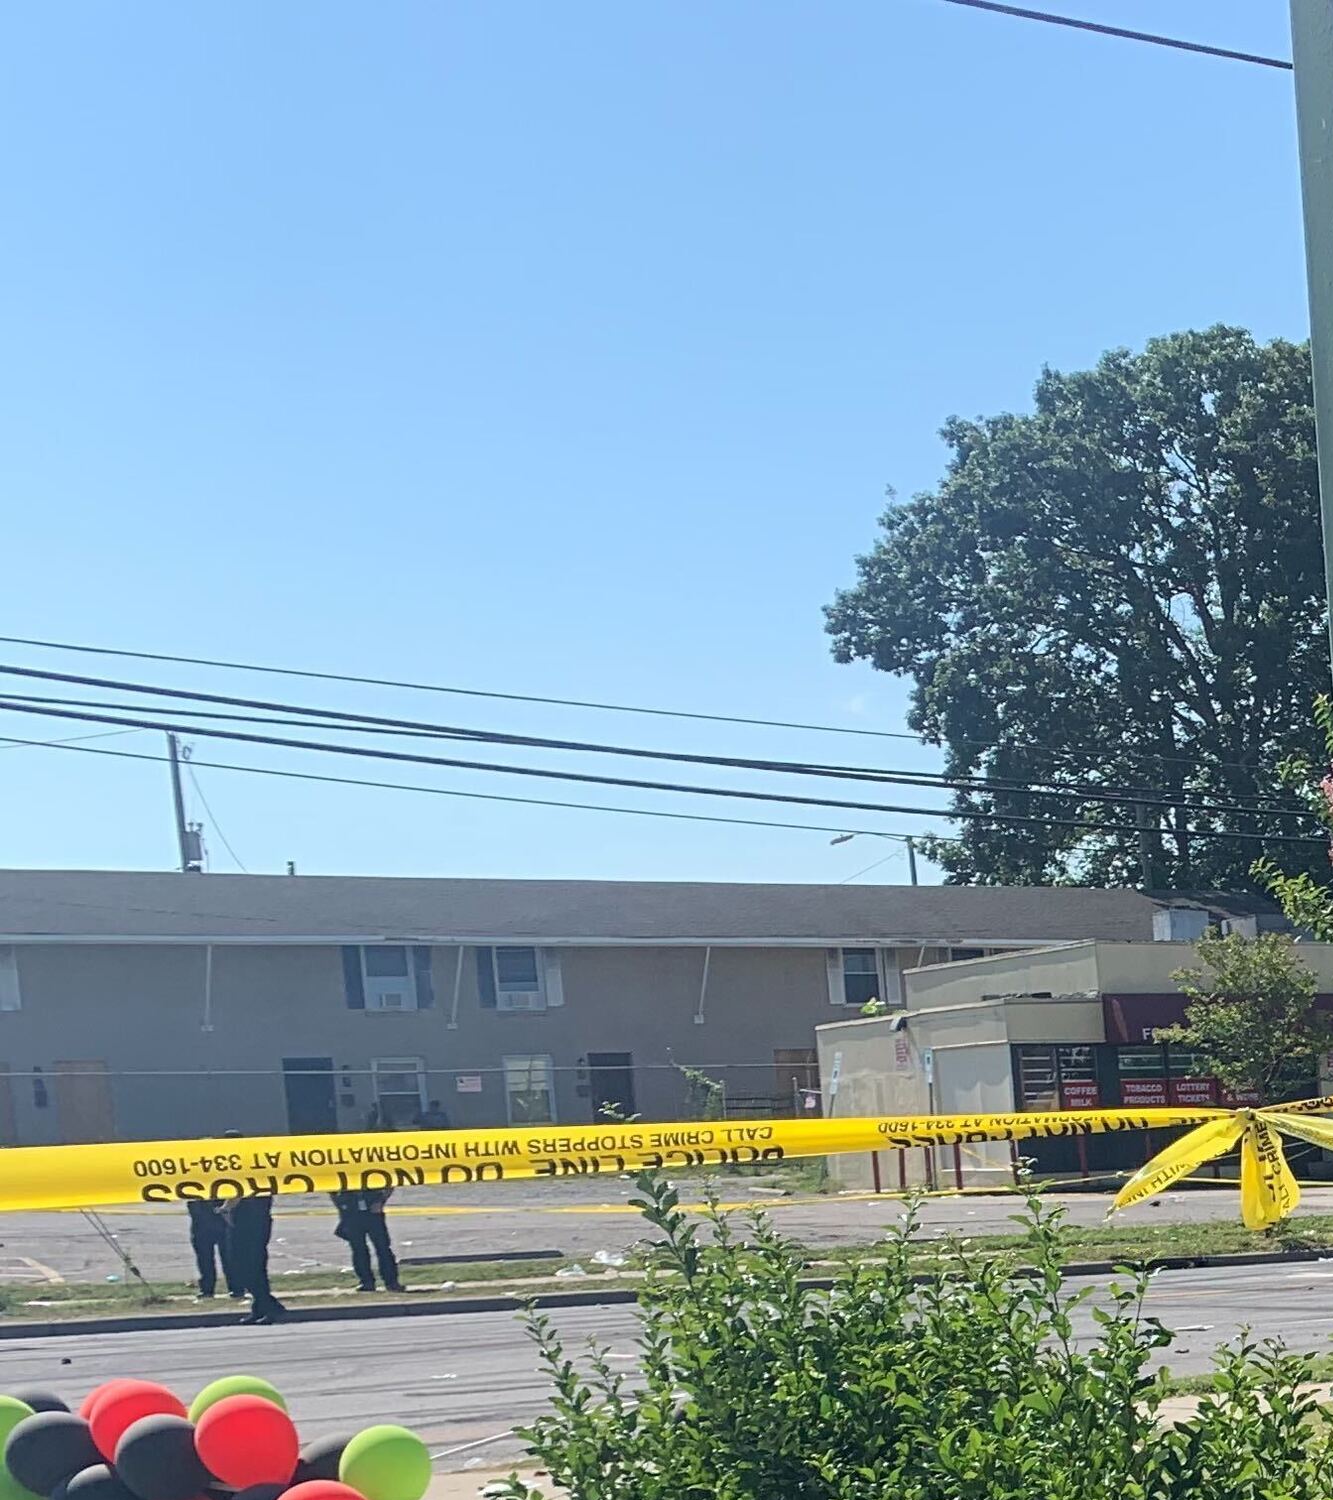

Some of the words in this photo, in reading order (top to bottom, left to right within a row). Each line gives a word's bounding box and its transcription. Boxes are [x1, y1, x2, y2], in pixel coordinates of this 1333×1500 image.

[1064, 1087, 1097, 1096] COFFEE
[1125, 1084, 1163, 1093] TOBACCO
[1176, 1083, 1211, 1092] LOTTERY
[1123, 1096, 1166, 1104] PRODUCTS
[1178, 1094, 1210, 1103] TICKETS
[650, 1131, 714, 1147] CRIME
[721, 1127, 773, 1141] CALL
[465, 1140, 521, 1156] WITH
[528, 1134, 643, 1155] STOPPERS
[252, 1152, 281, 1169] AT
[290, 1143, 458, 1167] INFORMATION
[637, 1145, 784, 1168] POLICE
[133, 1154, 242, 1177] 334-1600
[142, 1173, 314, 1202] CROSS
